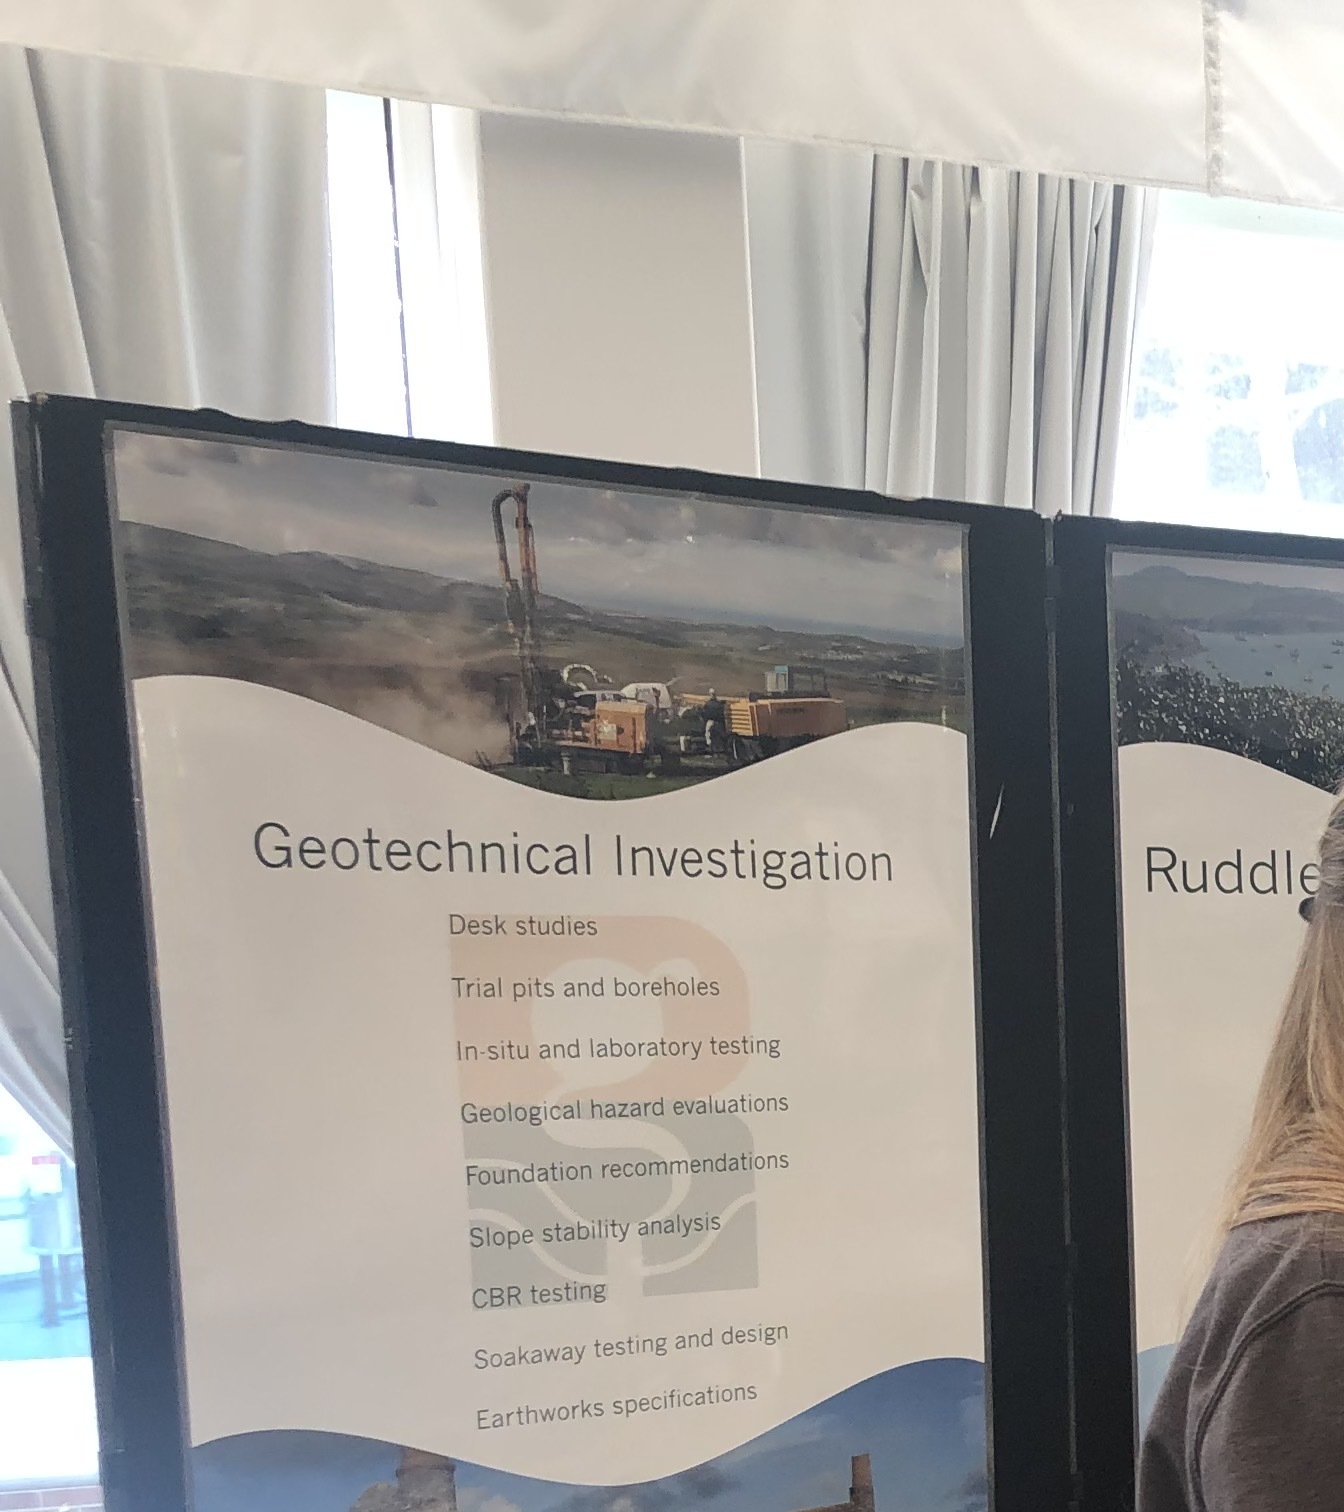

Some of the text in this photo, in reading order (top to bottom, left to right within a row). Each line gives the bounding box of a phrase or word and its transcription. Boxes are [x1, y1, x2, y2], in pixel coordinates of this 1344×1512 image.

[255, 822, 891, 889] Geotechnical Investigation
[450, 914, 597, 935] Desk studies
[452, 977, 719, 1002] Trial pits and boreholes
[458, 1036, 780, 1060] In-situ and laboratory testing
[461, 1095, 788, 1126] Geological hazard evaluations
[466, 1153, 789, 1185] Foundation recommendations
[470, 1214, 720, 1249] Slope stability analysis
[472, 1281, 606, 1309] CBR testing
[475, 1326, 788, 1369] Soakaway testing and design
[477, 1386, 757, 1429] Earthworks specifications
